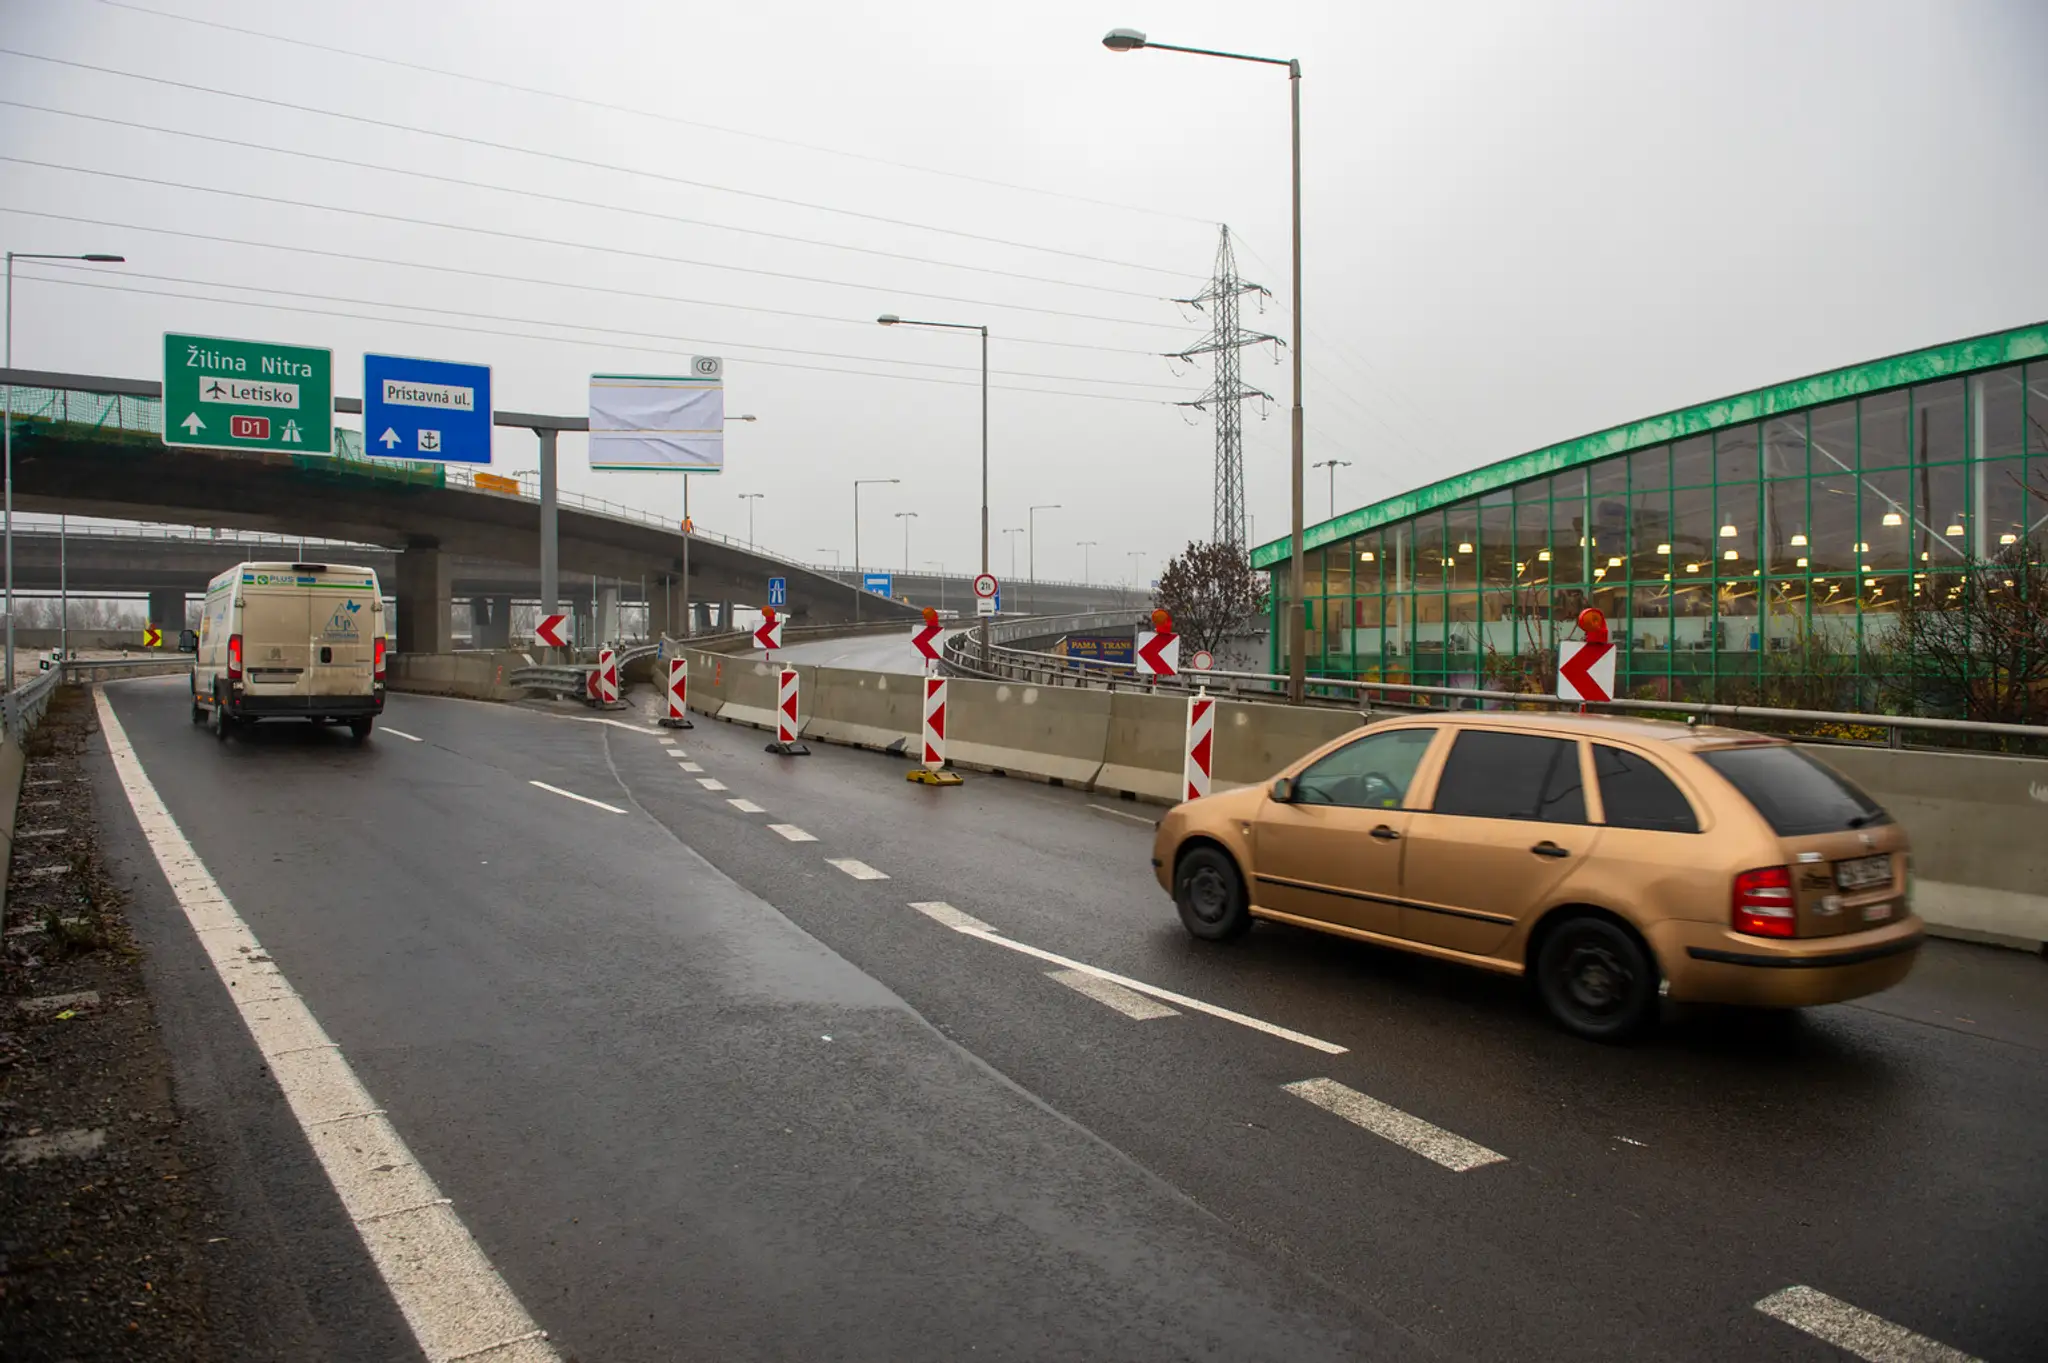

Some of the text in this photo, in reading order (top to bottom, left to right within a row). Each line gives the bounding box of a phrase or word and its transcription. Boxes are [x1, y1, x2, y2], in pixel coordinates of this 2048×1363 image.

[186, 344, 312, 377] Žilina Nitra
[701, 361, 712, 372] CZ
[231, 384, 293, 403] Letisko
[387, 385, 470, 406] Prístavná ul.
[241, 420, 261, 435] D1
[269, 575, 294, 583] PLUS
[1071, 641, 1097, 649] PAMA
